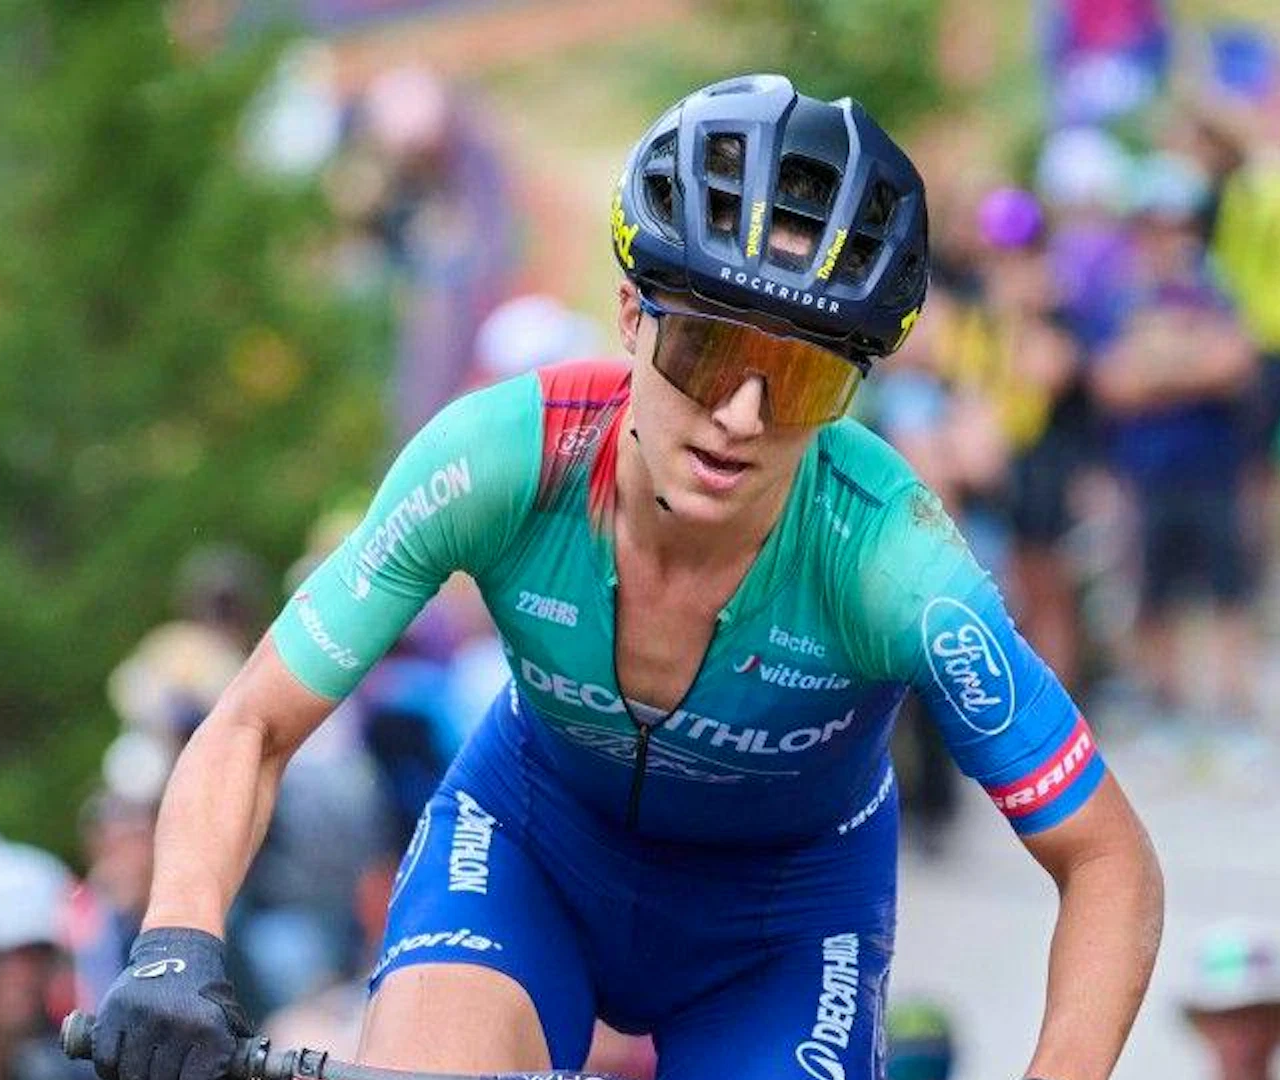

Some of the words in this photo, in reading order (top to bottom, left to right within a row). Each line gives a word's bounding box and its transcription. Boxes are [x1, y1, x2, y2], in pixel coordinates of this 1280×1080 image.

[720, 267, 840, 313] ROCKRIDER
[769, 624, 826, 659] tactic
[760, 662, 851, 691] vittoria
[521, 656, 855, 755] DECTHLON
